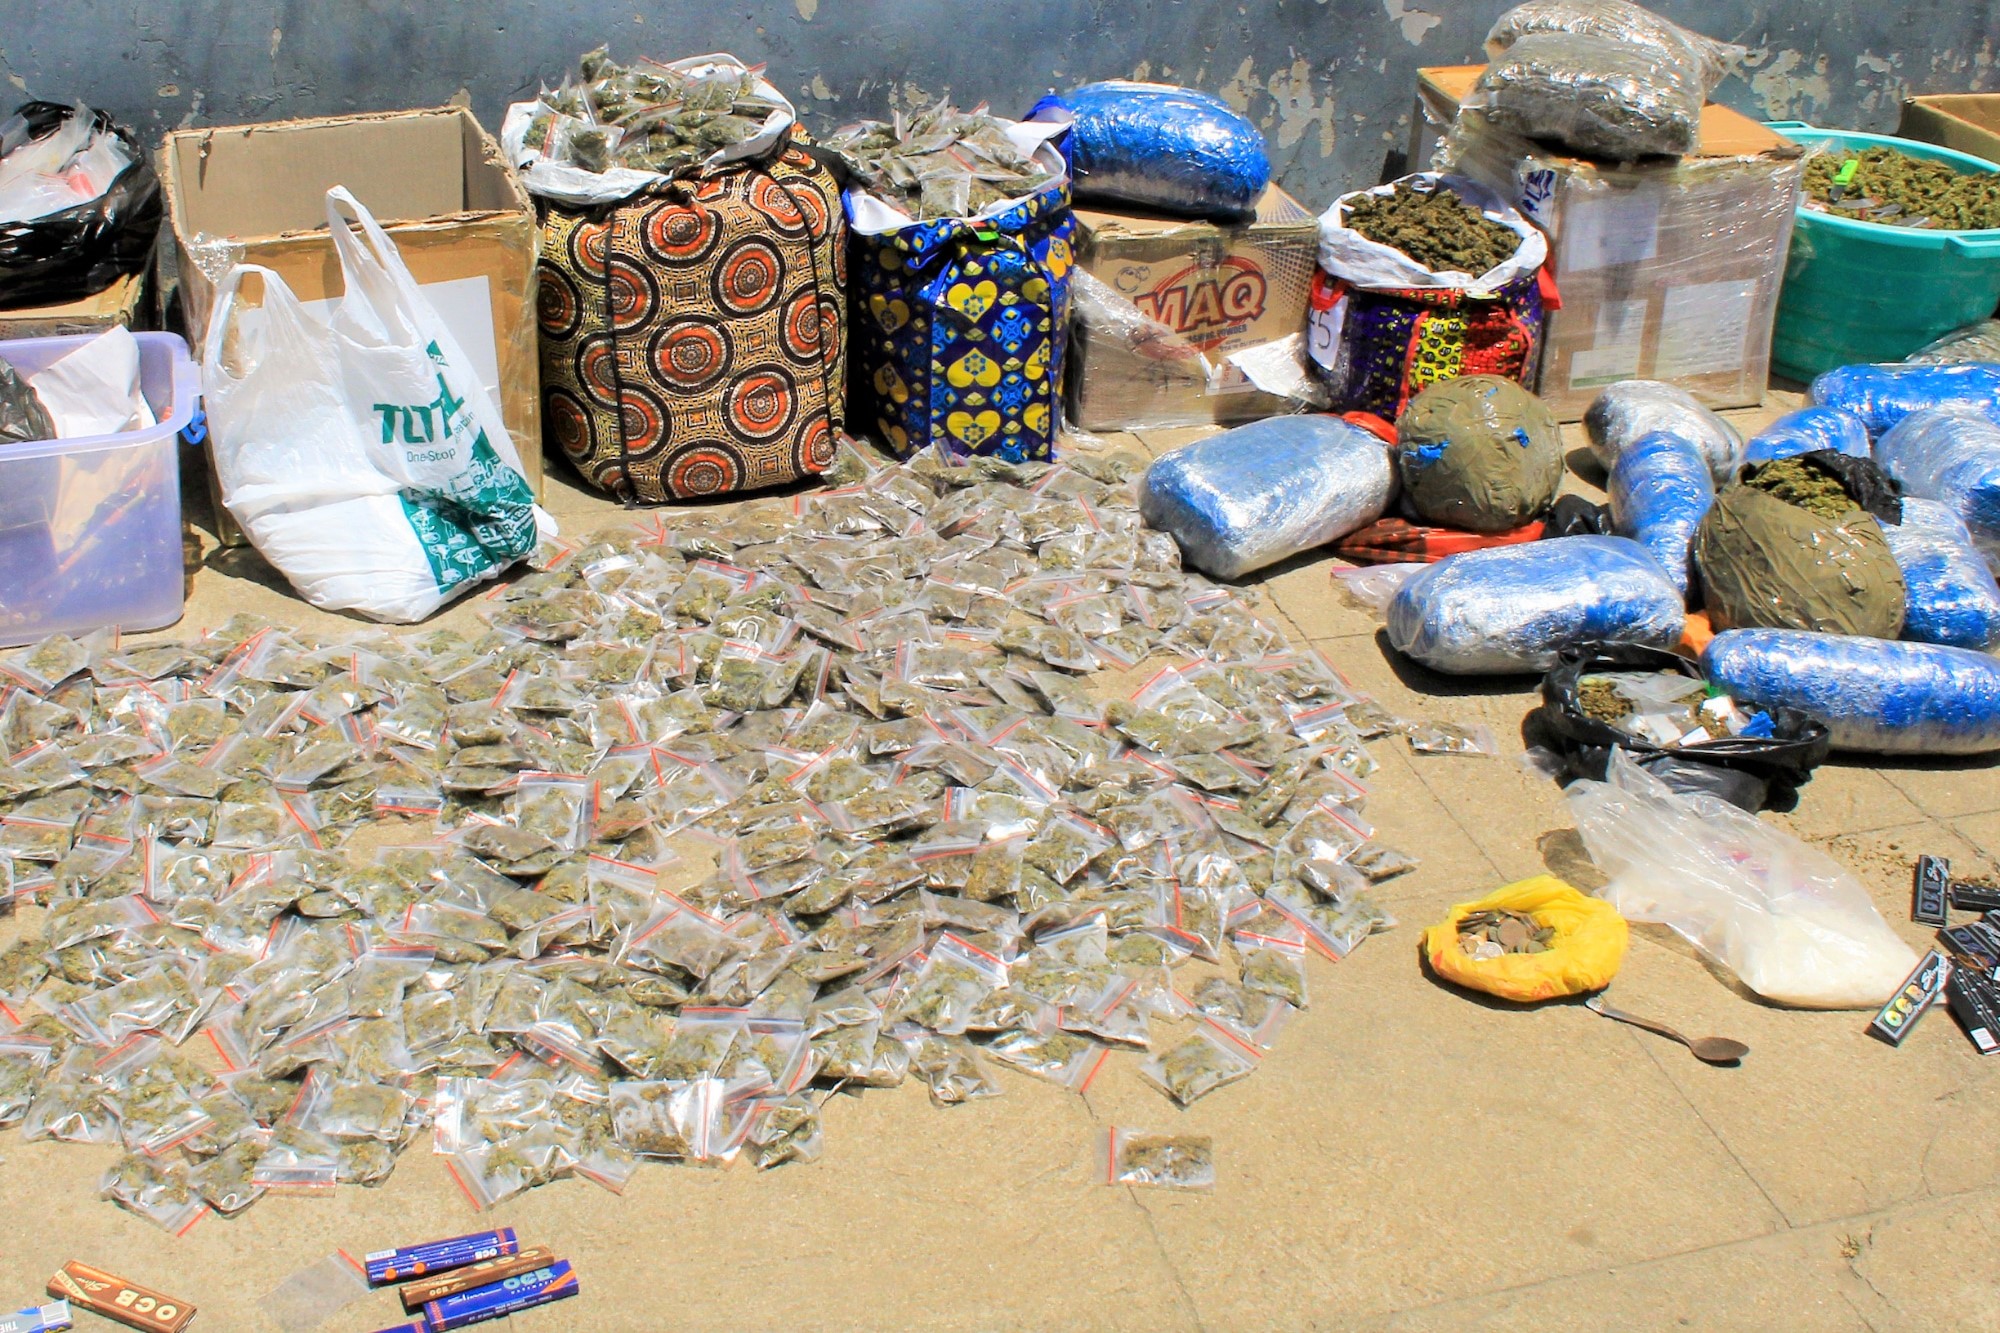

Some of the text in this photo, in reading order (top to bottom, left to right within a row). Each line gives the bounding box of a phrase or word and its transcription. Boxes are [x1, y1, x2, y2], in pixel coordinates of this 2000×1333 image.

[1134, 271, 1267, 333] MAQ
[407, 447, 457, 463] One-Stop
[1884, 984, 1925, 1027] OCB
[474, 1247, 498, 1259] OCB
[503, 1267, 553, 1289] OCB
[429, 1286, 448, 1296] OCB
[115, 1288, 177, 1320] OCB
